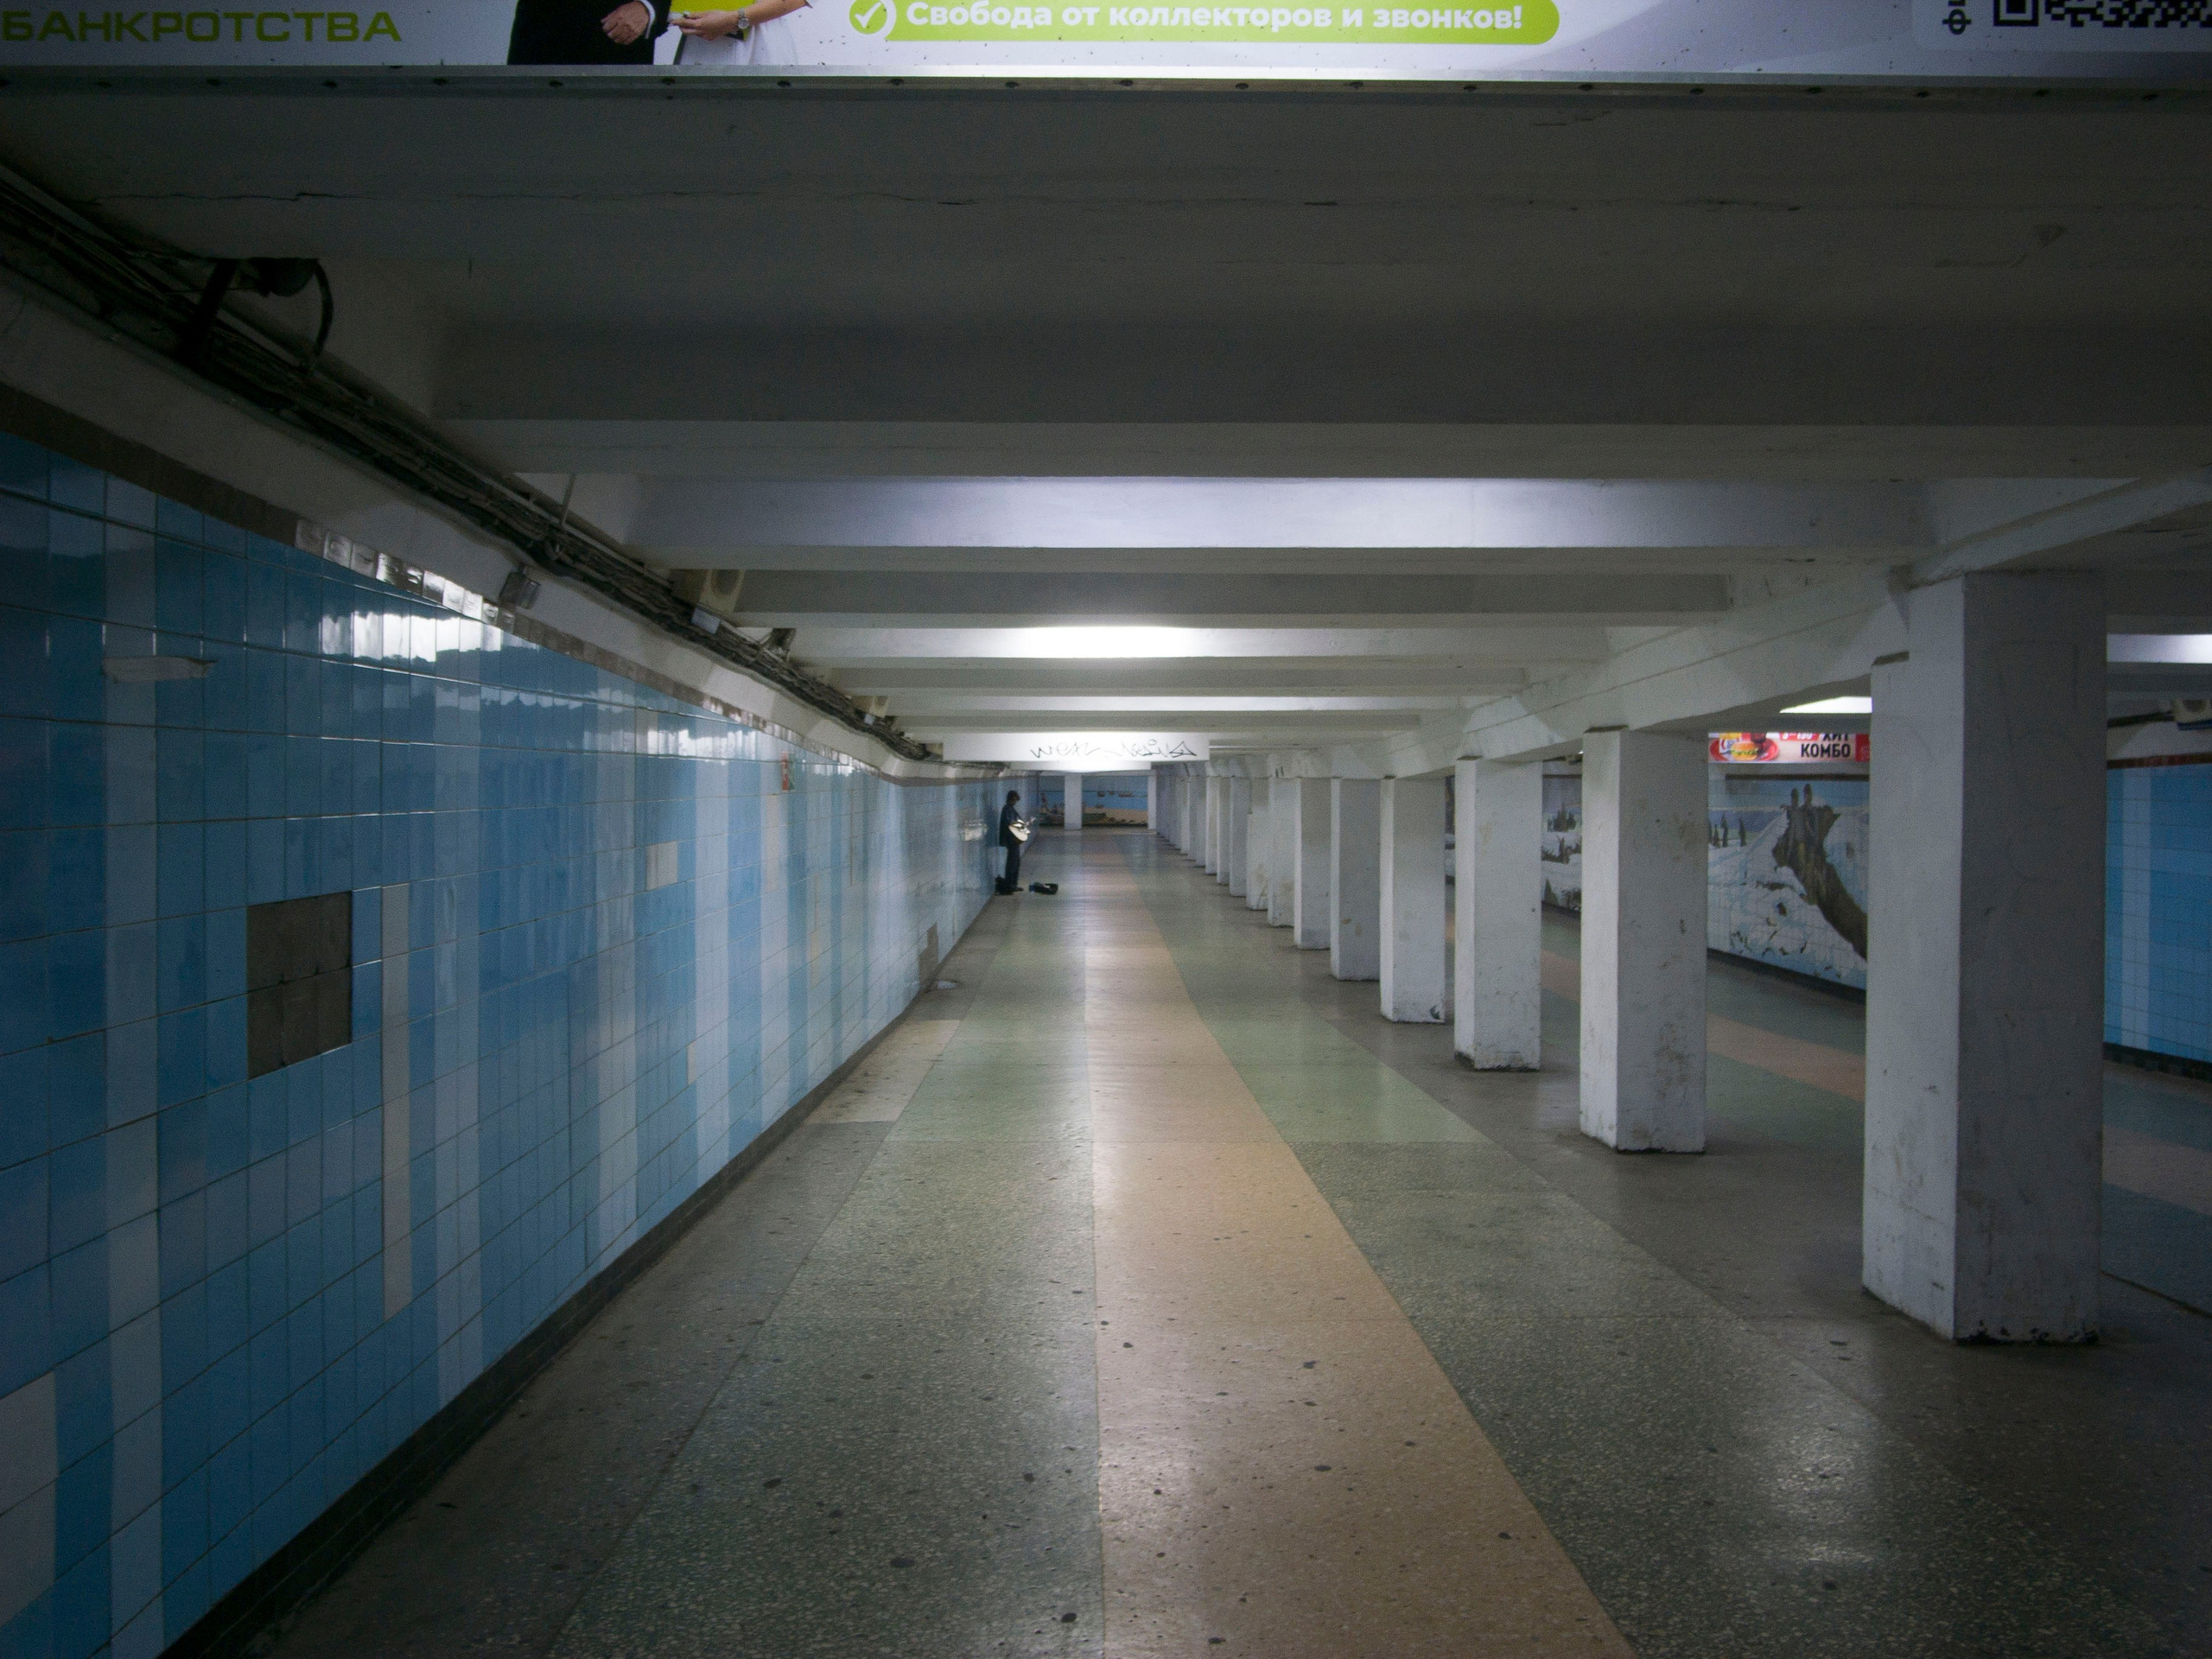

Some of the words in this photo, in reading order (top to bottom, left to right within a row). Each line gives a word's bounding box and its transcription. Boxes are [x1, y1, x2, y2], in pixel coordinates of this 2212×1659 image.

[2, 11, 402, 41] БАНКРОТСТВА
[906, 0, 1052, 29] Свобода
[1062, 7, 1099, 26] от
[1109, 7, 1332, 32] коллекторов
[1342, 9, 1363, 28] и
[1373, 5, 1522, 29] звонков!
[1801, 744, 1851, 758] КОМБО
